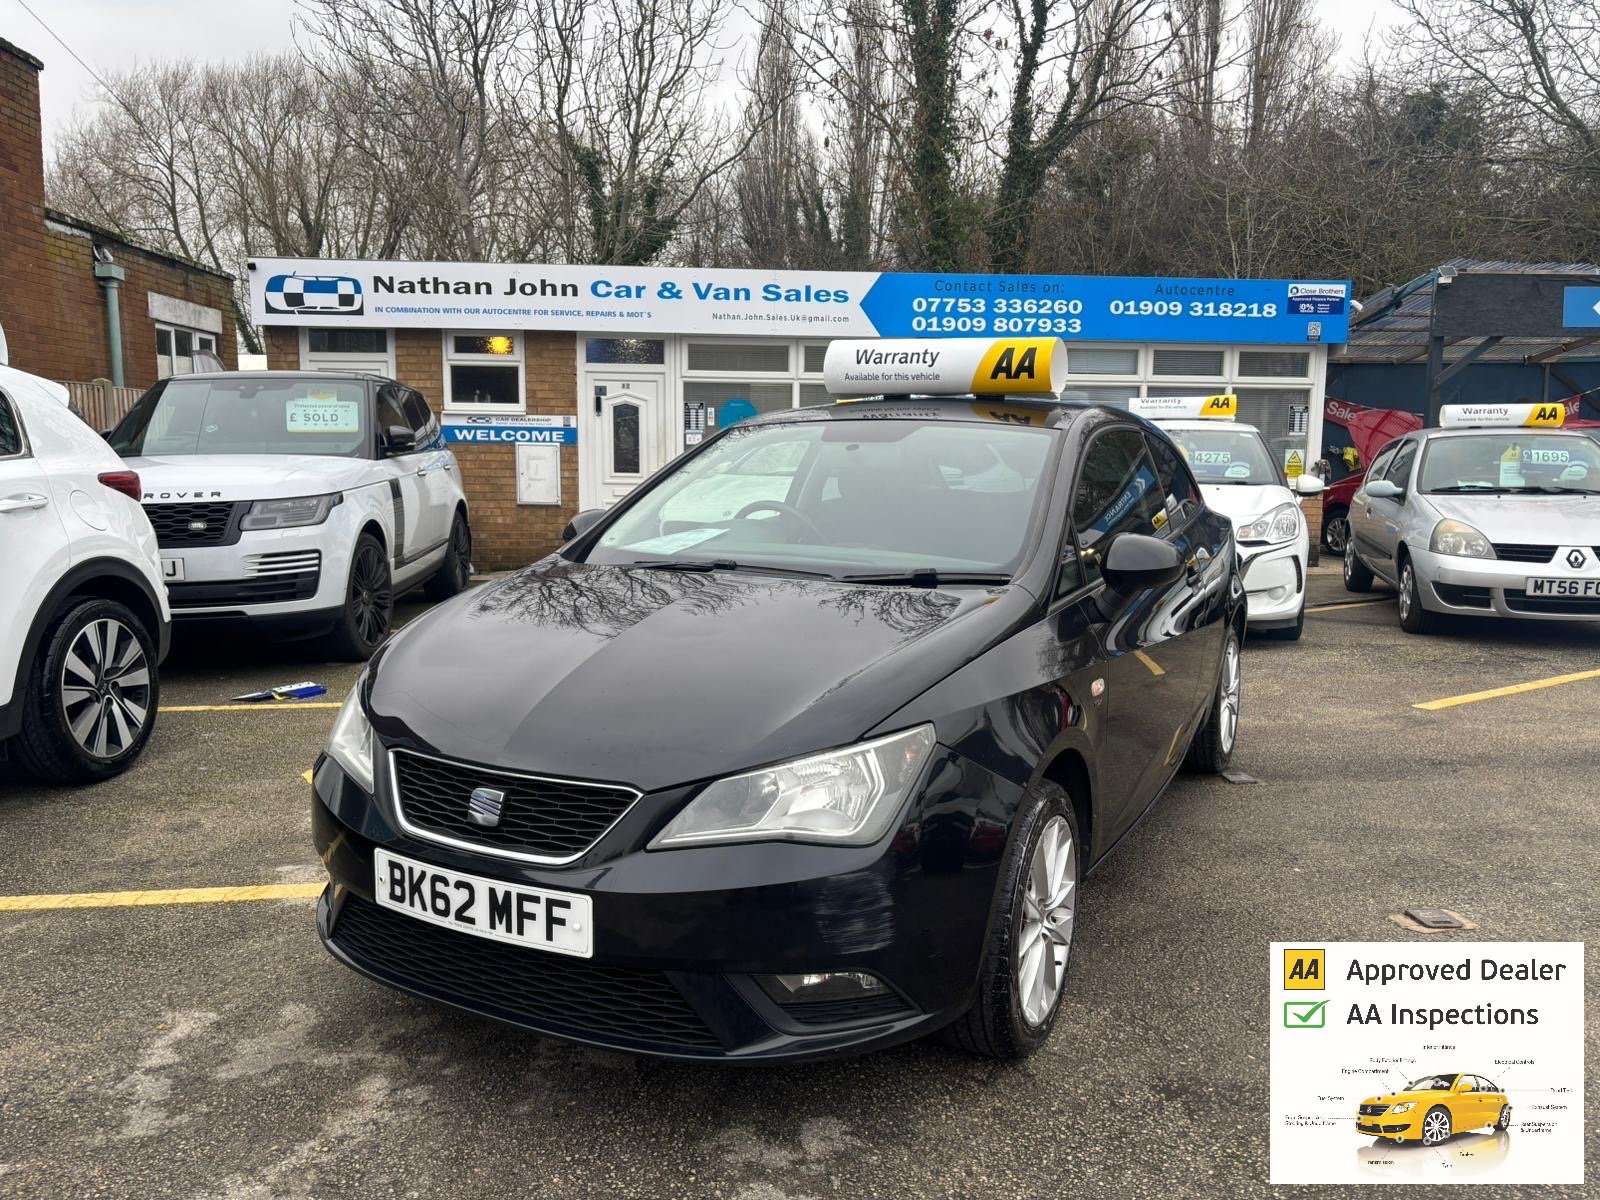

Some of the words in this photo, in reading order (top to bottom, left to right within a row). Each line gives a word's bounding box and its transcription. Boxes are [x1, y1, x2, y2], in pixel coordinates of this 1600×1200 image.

[373, 275, 493, 296] Nathan
[503, 277, 579, 297] John
[590, 279, 647, 299] Car
[656, 281, 683, 300] &
[691, 282, 751, 302] Van
[761, 284, 850, 304] Sales
[934, 279, 992, 292] Contact
[999, 281, 1036, 293] Sales
[1155, 283, 1235, 297] Autocentre
[385, 306, 440, 314] COMBINATION
[463, 307, 481, 315] OUR
[482, 308, 532, 316] AUTOCENTRE
[533, 308, 549, 316] FOR
[586, 310, 617, 318] REPAIRS
[912, 297, 986, 313] 07753
[992, 299, 1084, 315] 336260
[1109, 299, 1183, 316] 01909
[1188, 301, 1278, 318] 318218
[912, 316, 987, 332] 01909
[993, 317, 1082, 333] 807933
[855, 348, 941, 368] Warranty
[991, 346, 1038, 380] AA
[844, 372, 880, 381] Available
[881, 372, 893, 381] for
[894, 372, 909, 381] this
[911, 372, 941, 381] vehicle
[1209, 397, 1230, 409] AA
[303, 412, 339, 422] SOLD
[1326, 401, 1357, 421] Sale
[1462, 407, 1509, 416] Warranty
[1535, 407, 1558, 420] AA
[454, 429, 565, 442] WELCOME
[143, 491, 221, 499] ROVER
[1533, 579, 1579, 595] MT56
[388, 859, 476, 926] BK62
[488, 886, 572, 942] MFF
